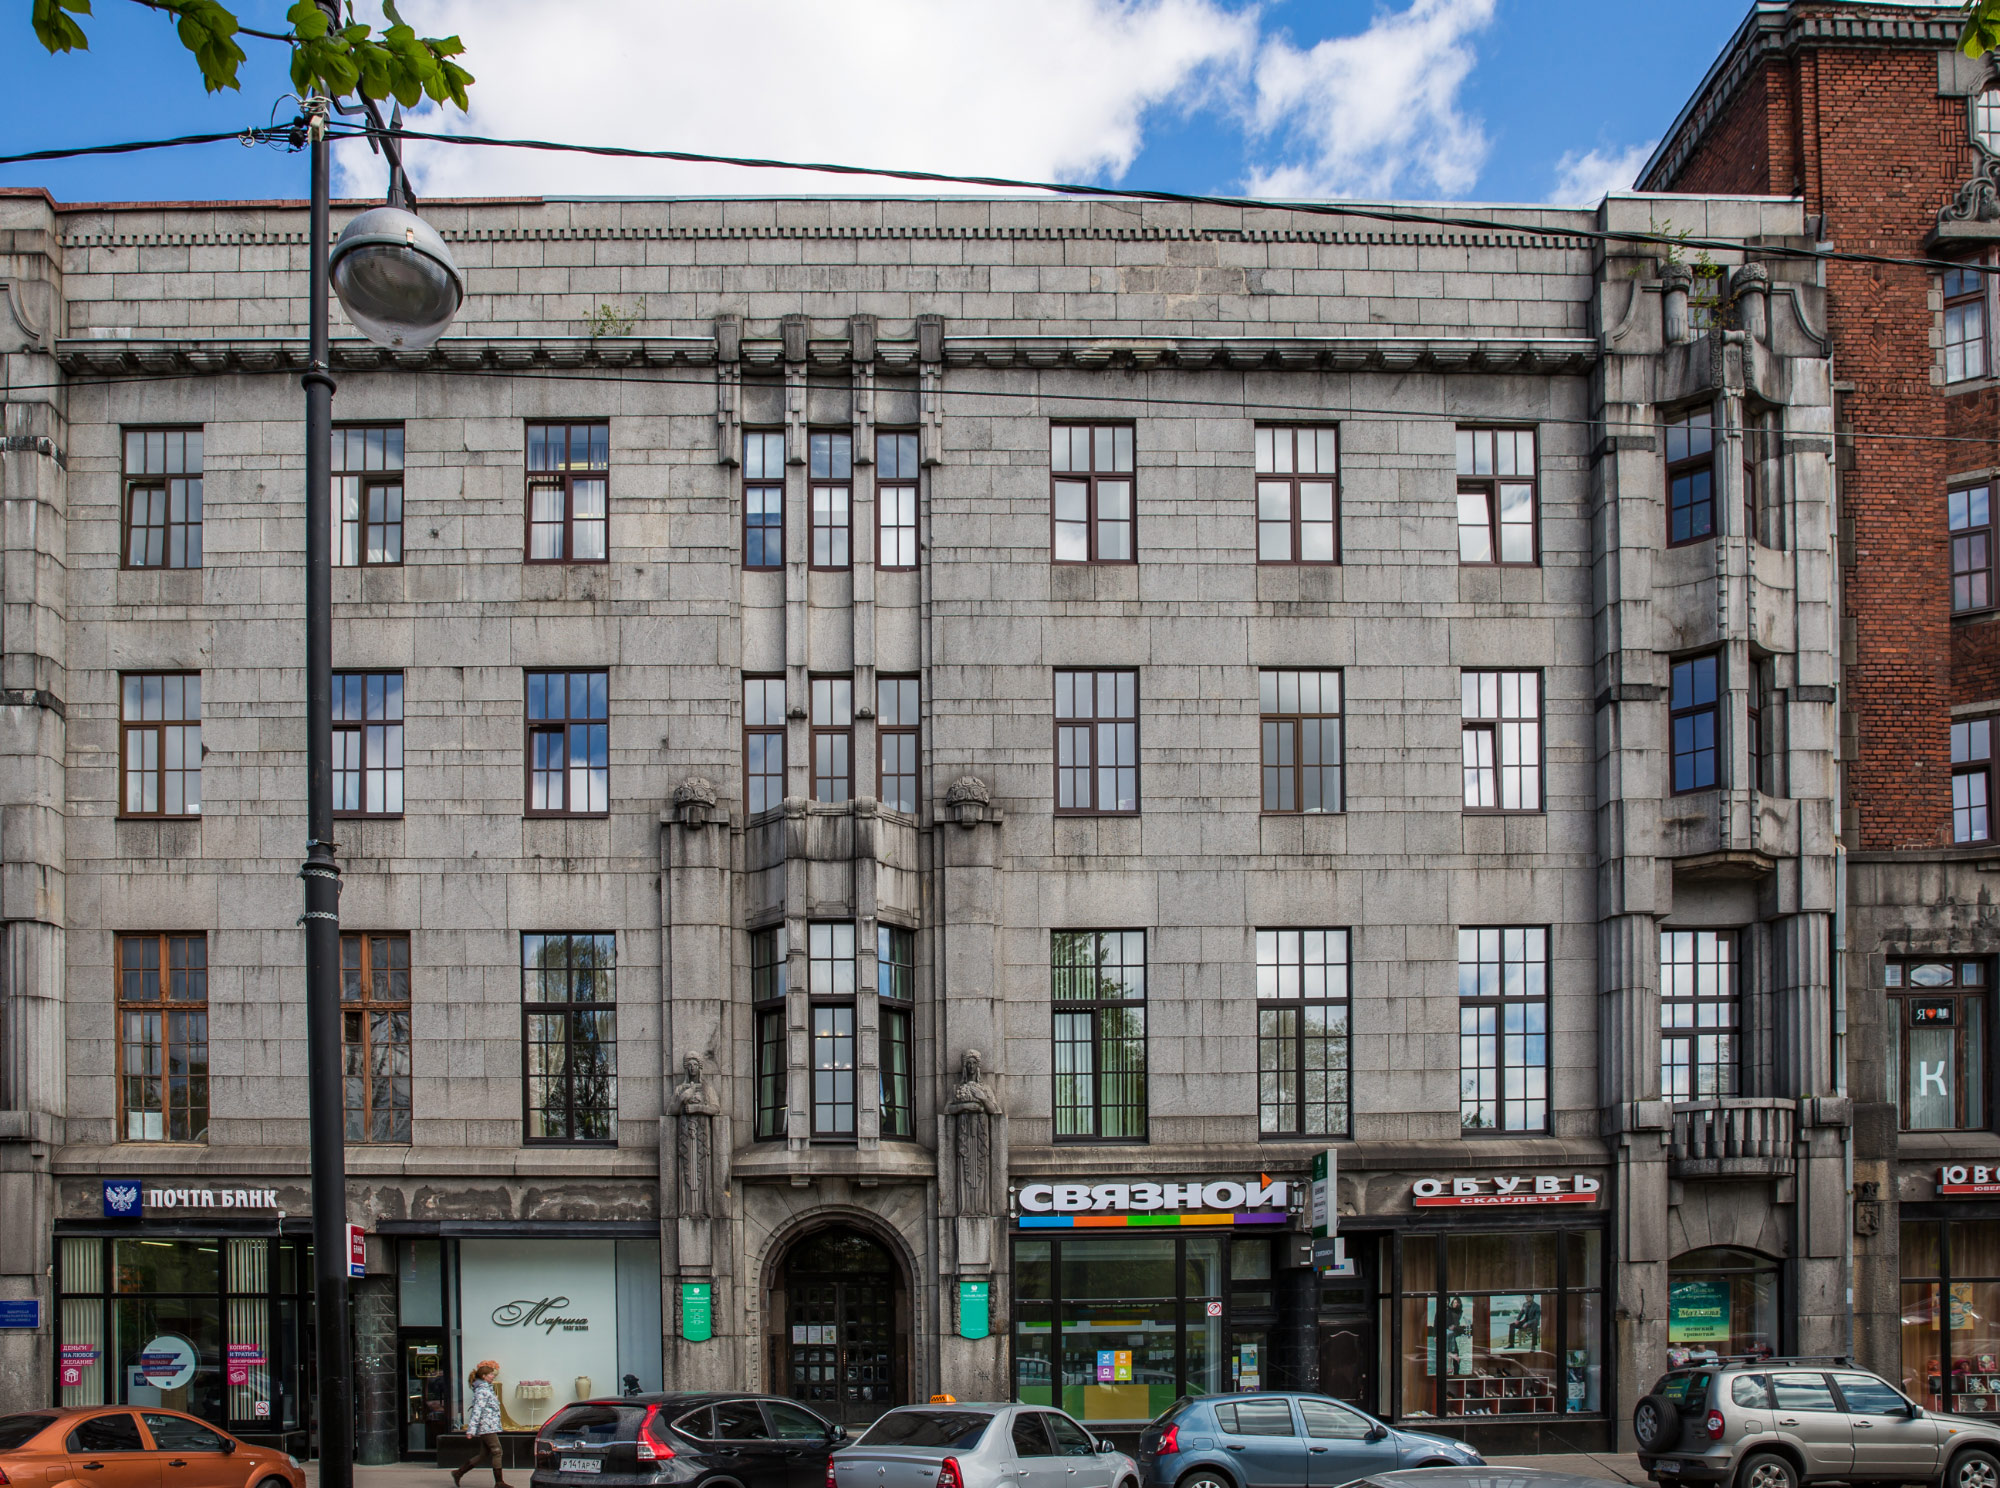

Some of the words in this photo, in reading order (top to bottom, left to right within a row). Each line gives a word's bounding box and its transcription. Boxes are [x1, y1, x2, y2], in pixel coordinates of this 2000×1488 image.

[1916, 1008, 1926, 1020] Я
[1019, 1173, 1287, 1212] СВЯЗНОЙ
[1412, 1175, 1600, 1196] ОБУВЬ
[150, 1189, 215, 1208] ПОЧТА
[221, 1189, 278, 1208] БАНК
[1460, 1195, 1564, 1204] СКАРЛЕТТ
[491, 1296, 588, 1335] Марина
